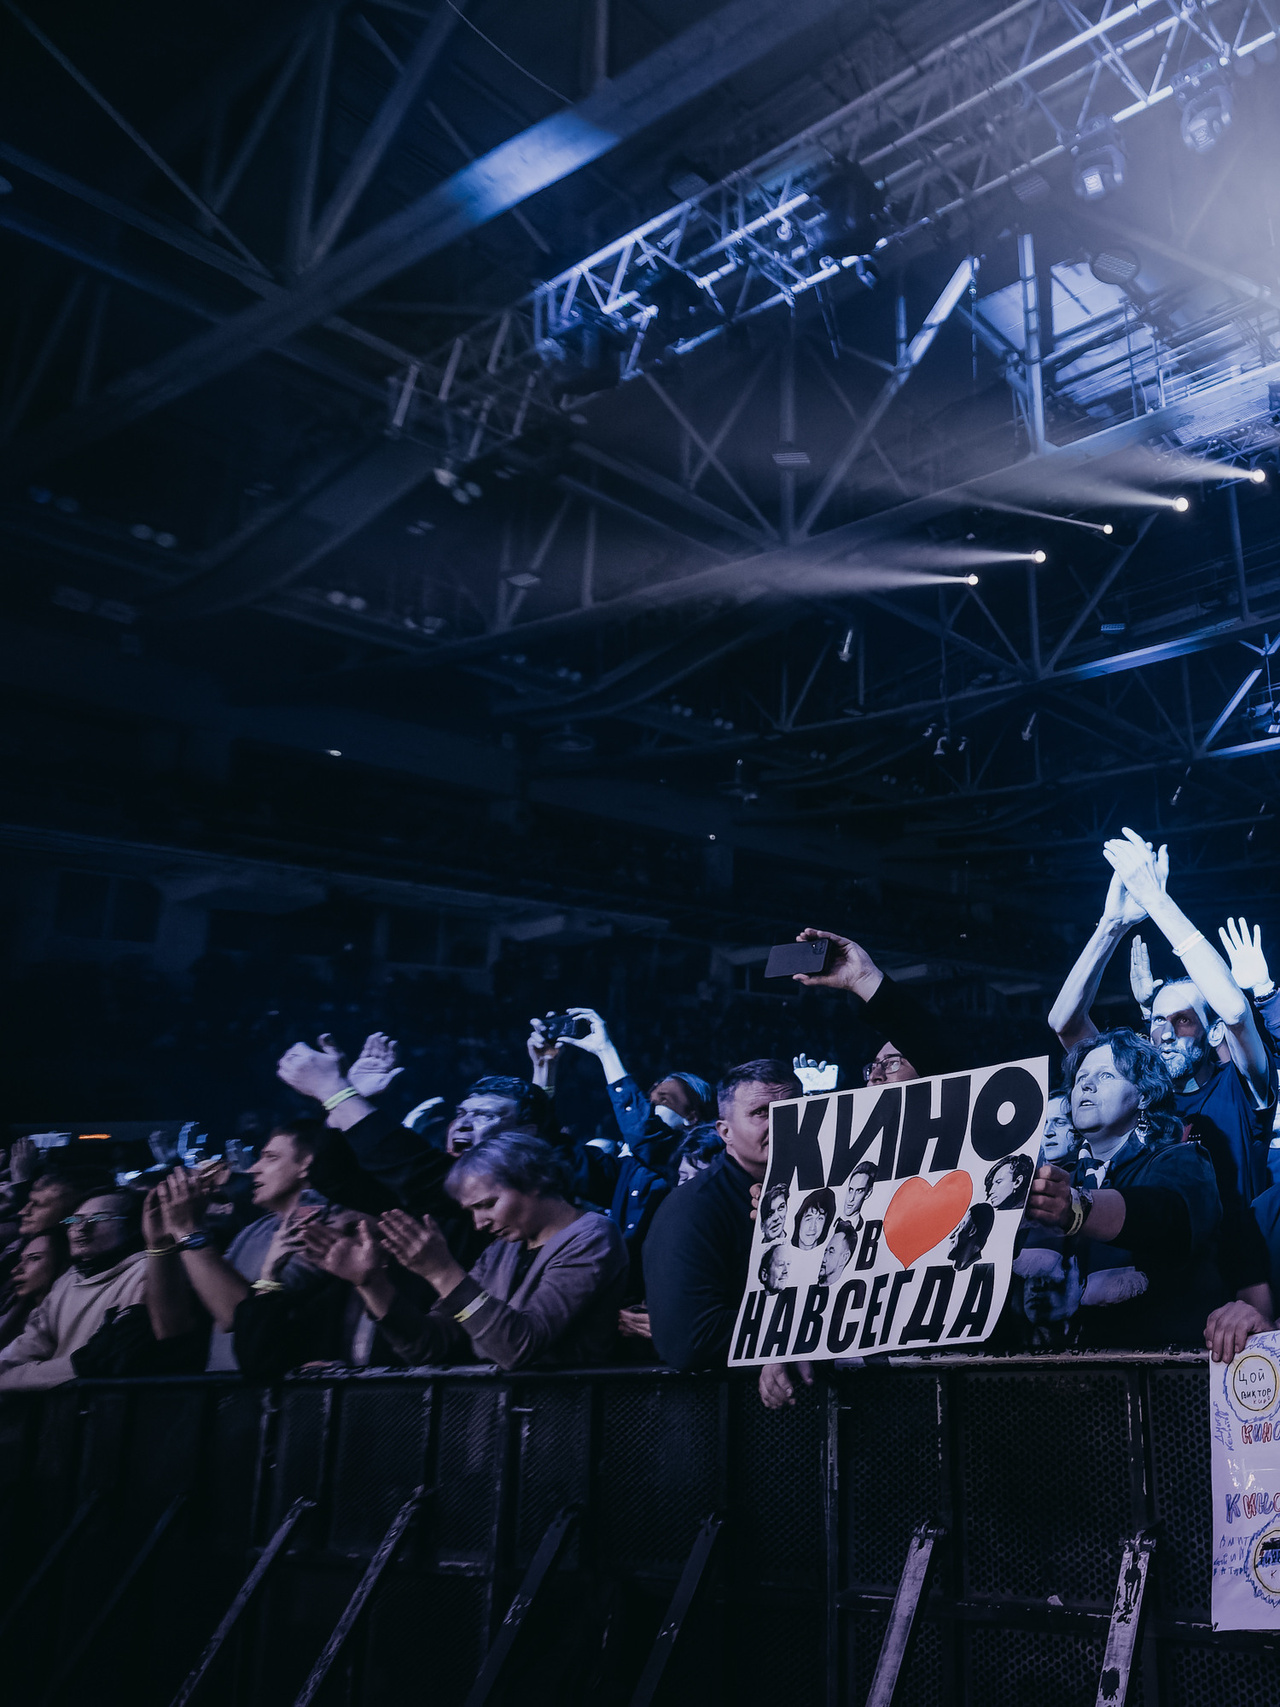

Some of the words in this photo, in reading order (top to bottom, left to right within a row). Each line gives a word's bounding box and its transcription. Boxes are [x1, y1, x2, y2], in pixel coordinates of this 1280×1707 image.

[767, 1066, 1044, 1192] КИНО
[855, 1220, 883, 1272] В
[733, 1263, 995, 1361] НАВСЕГДА
[1238, 1368, 1265, 1386] ЦОЙ
[1240, 1387, 1272, 1400] ВИКТОР
